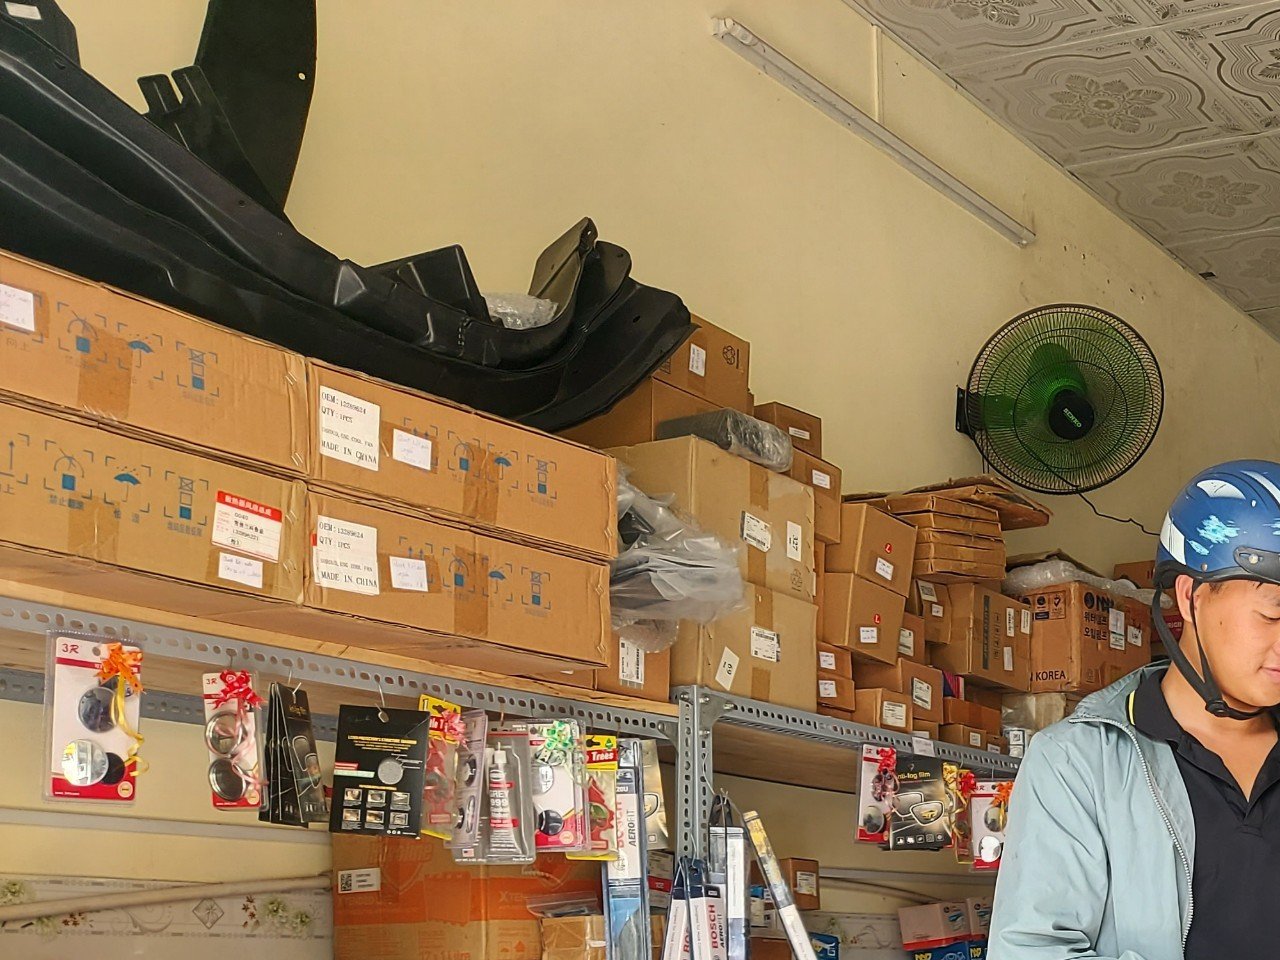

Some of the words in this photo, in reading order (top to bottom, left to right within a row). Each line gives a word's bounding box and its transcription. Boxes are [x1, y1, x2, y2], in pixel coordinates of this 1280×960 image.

[321, 440, 340, 453] MADE
[343, 446, 352, 456] IN
[355, 451, 377, 465] CHINA
[321, 571, 340, 583] MADE
[344, 574, 353, 584] IN
[356, 577, 378, 588] CHINA
[61, 643, 80, 655] 3R
[1035, 670, 1066, 681] KOREA
[591, 751, 614, 761] Trees
[707, 904, 719, 949] BOSCH
